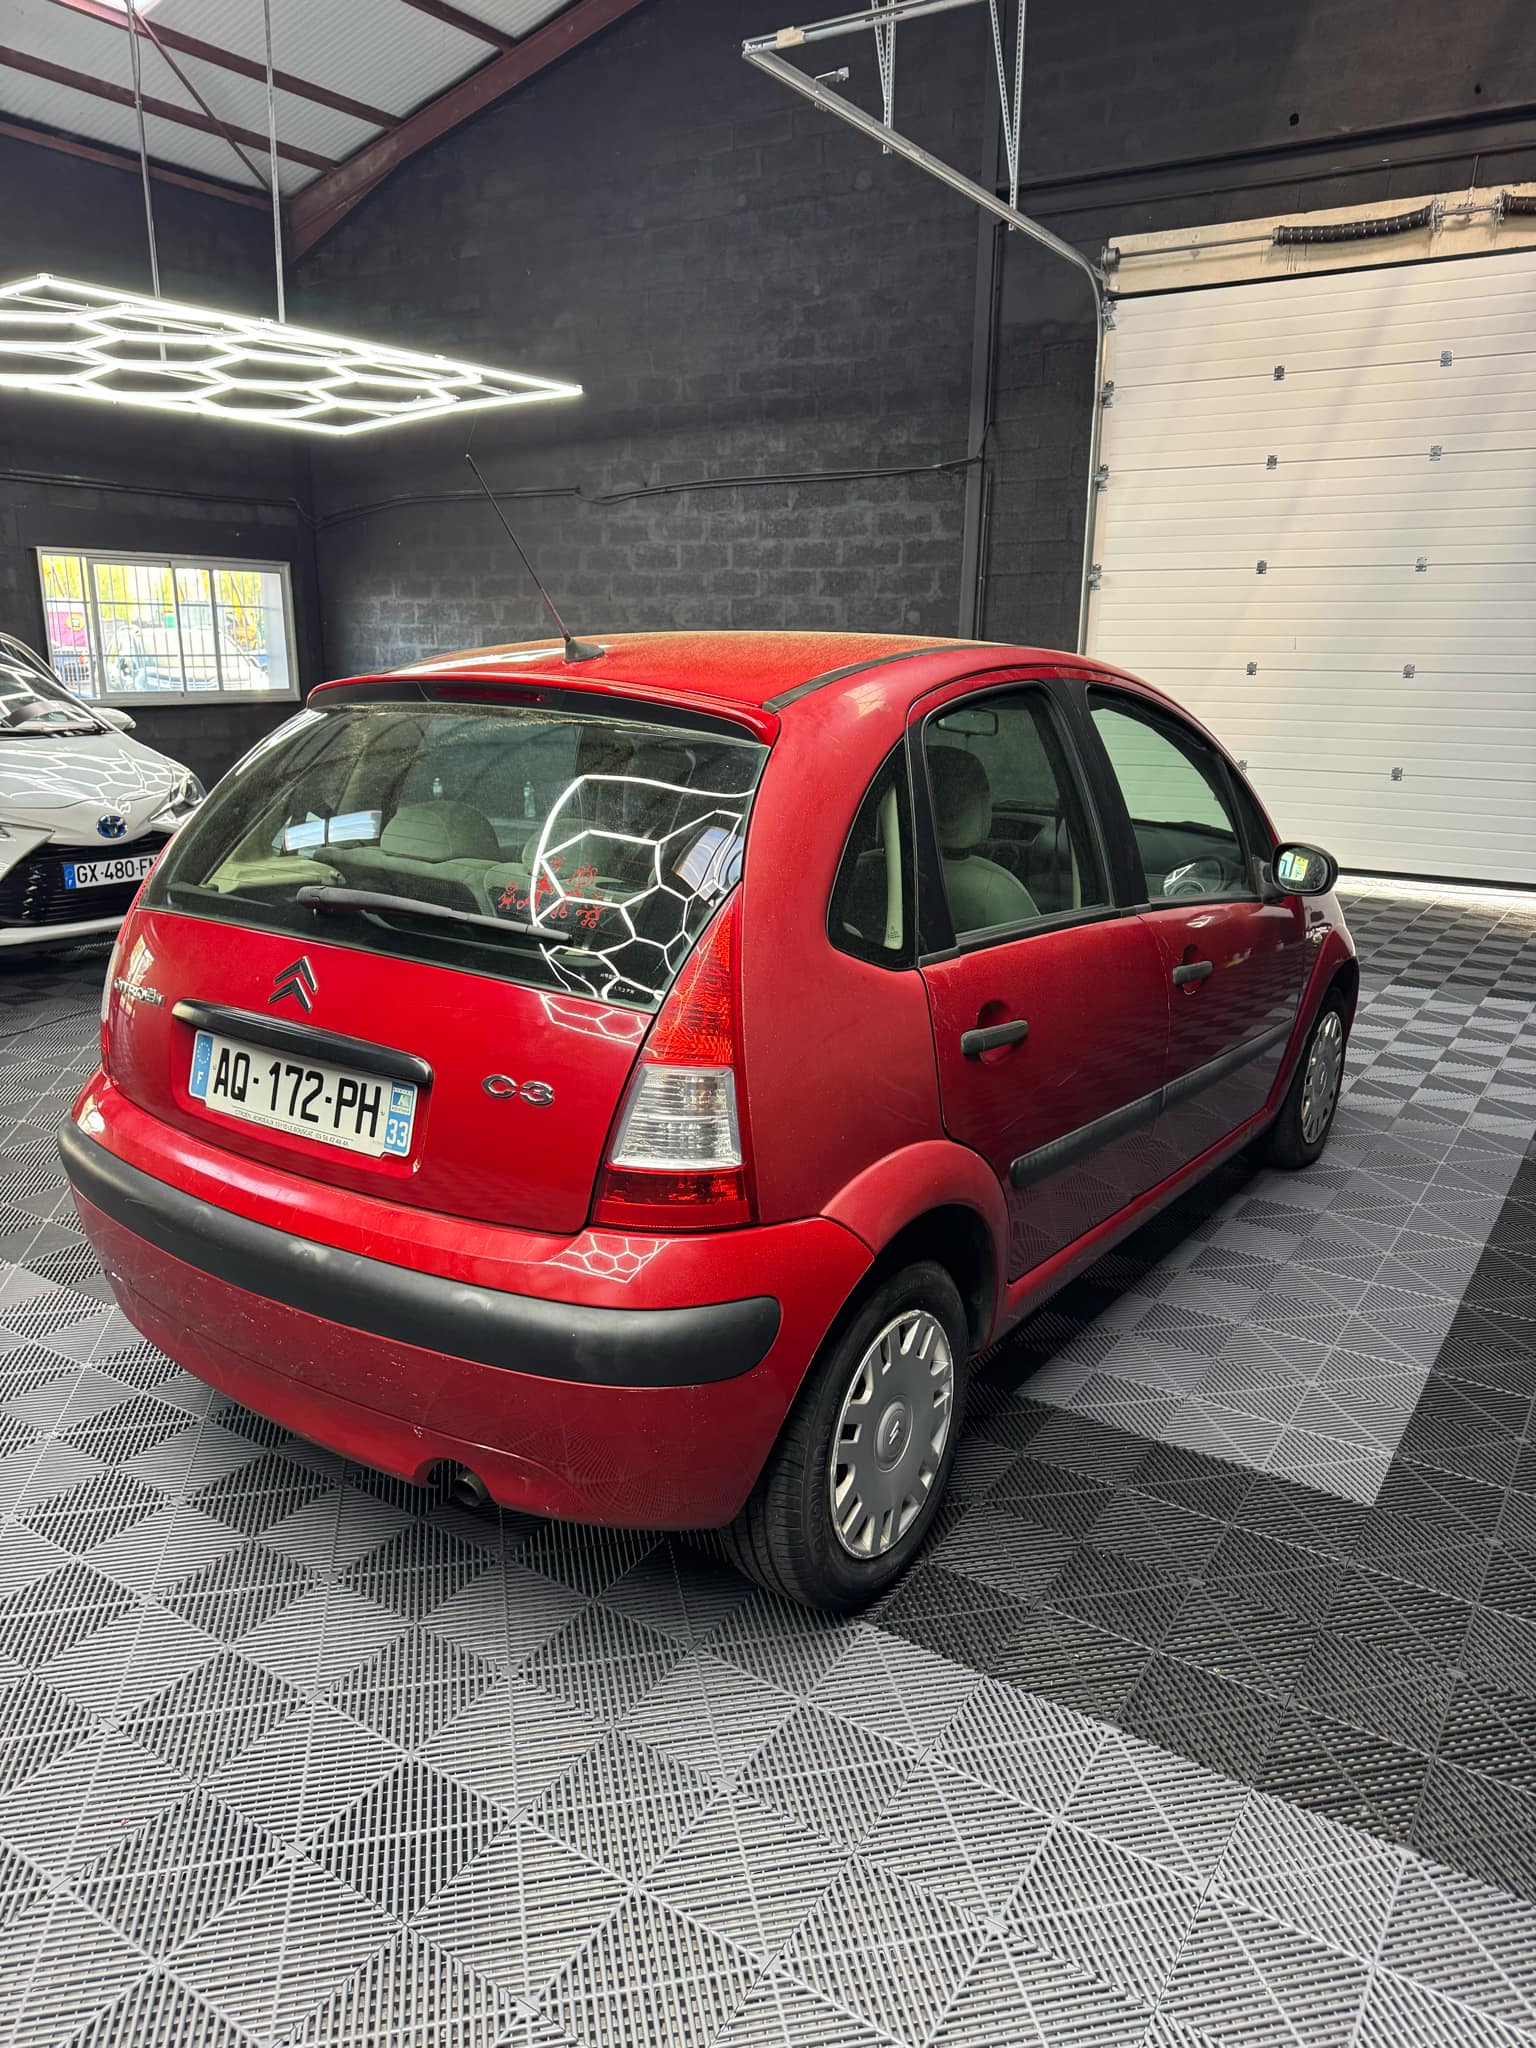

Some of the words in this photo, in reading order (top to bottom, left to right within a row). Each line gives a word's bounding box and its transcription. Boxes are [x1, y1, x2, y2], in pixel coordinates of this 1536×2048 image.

[196, 1071, 204, 1085] F
[213, 1047, 382, 1138] AQ-172-PH
[385, 1118, 409, 1147] 33
